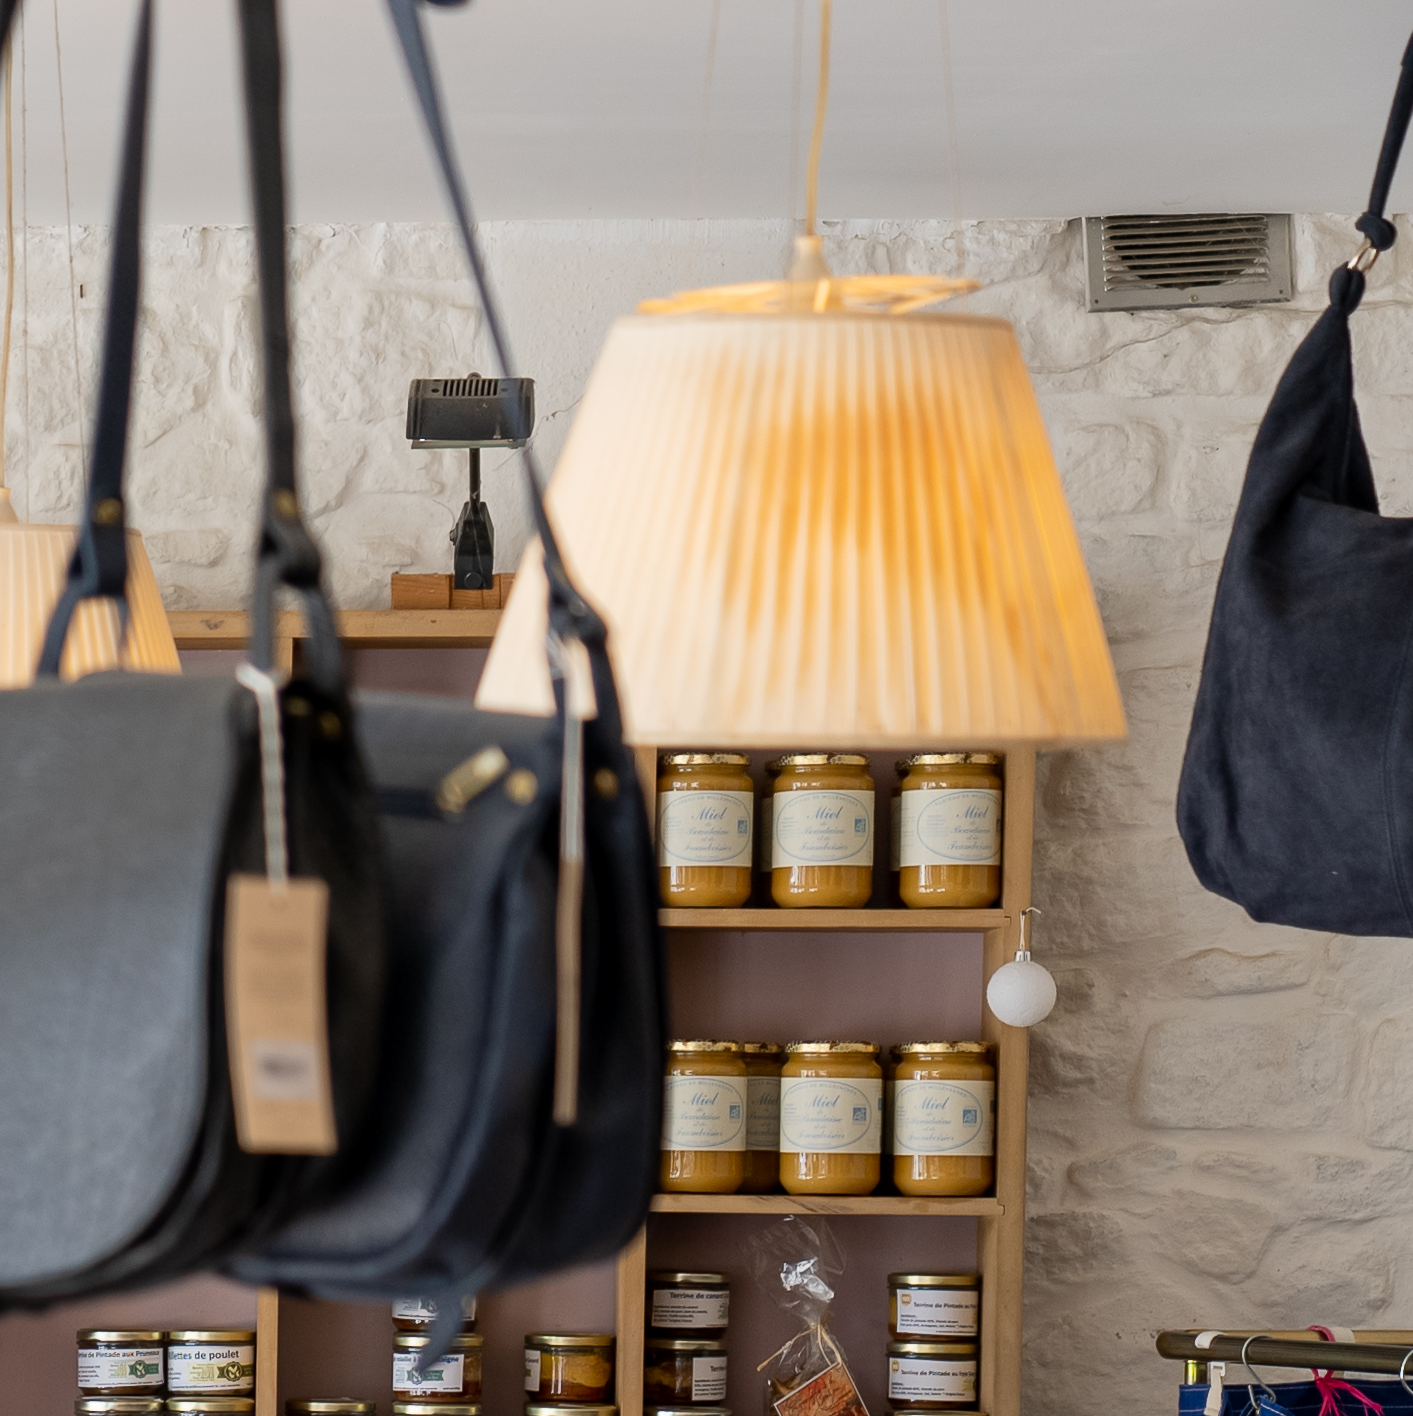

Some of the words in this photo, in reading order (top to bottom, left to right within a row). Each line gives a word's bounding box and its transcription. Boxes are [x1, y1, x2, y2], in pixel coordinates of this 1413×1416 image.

[691, 807, 727, 821] Miel
[806, 806, 841, 820] Miel
[683, 1093, 716, 1106] Miel
[805, 1093, 838, 1107] Miel
[914, 1095, 948, 1109] Miel
[195, 1350, 207, 1359] de
[209, 1350, 240, 1361] poulet
